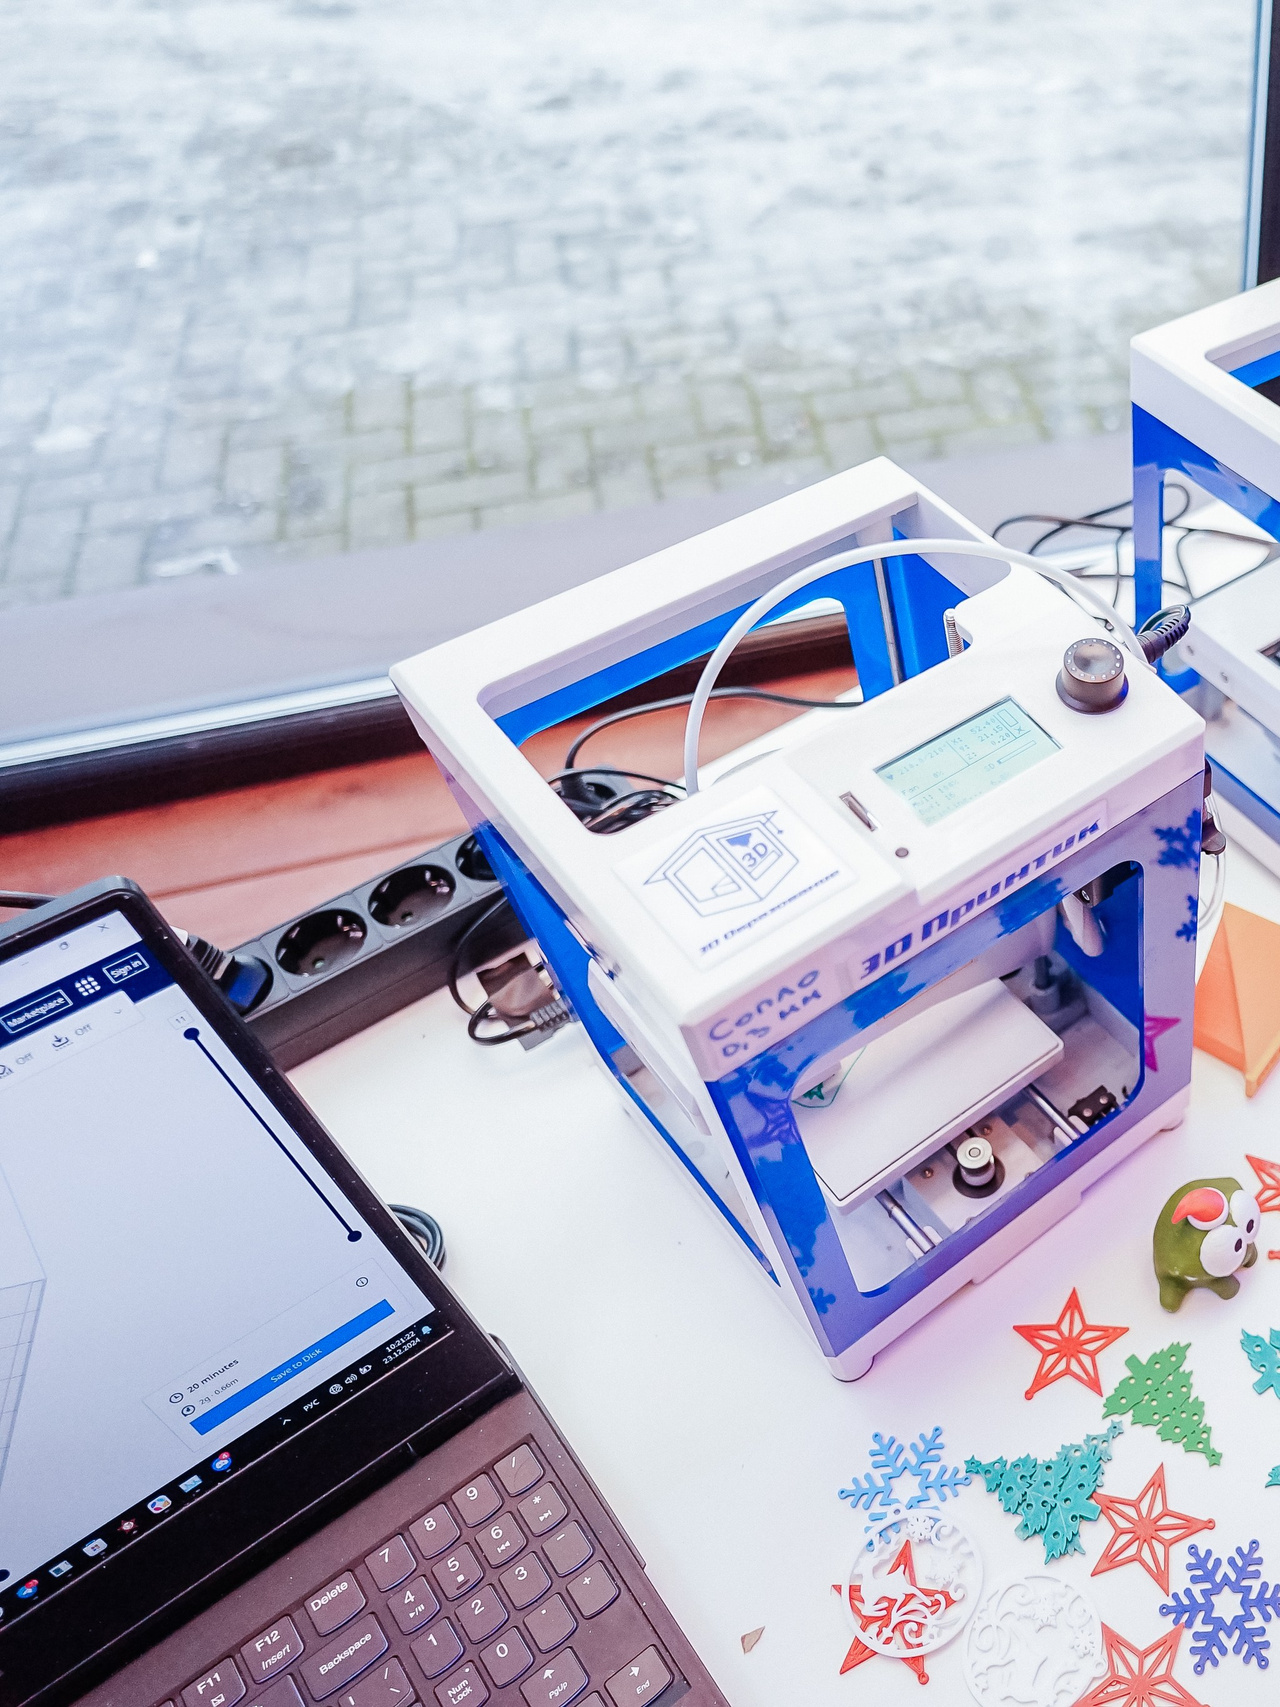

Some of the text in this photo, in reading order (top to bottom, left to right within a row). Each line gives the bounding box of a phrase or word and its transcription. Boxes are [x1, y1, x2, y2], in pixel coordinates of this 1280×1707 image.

[741, 842, 769, 868] 3D
[860, 819, 1101, 980] 3D Принтик
[110, 964, 133, 977] Sign
[6, 996, 66, 1027] Marketplace
[75, 1024, 93, 1036] Off
[16, 1053, 34, 1065] Off
[385, 1330, 416, 1353] 10:21:22
[382, 1337, 421, 1365] 23.12.2024
[270, 1347, 323, 1383] Save to Disk
[187, 1359, 240, 1394] 20 minutes
[199, 1396, 212, 1405] 2g
[466, 1487, 478, 1500] 9
[424, 1517, 437, 1531] 8
[491, 1526, 503, 1540] 6
[379, 1548, 390, 1563] 7
[447, 1558, 459, 1571] 5
[515, 1567, 528, 1581] 3
[311, 1581, 349, 1612] Delete
[404, 1591, 415, 1605] 4
[471, 1600, 484, 1615] 2
[255, 1630, 281, 1652] F12
[427, 1634, 438, 1647] 1
[261, 1643, 292, 1670] Insert
[319, 1633, 372, 1675] Backspace
[496, 1643, 508, 1658] 0
[197, 1672, 221, 1694] F11
[447, 1679, 469, 1697] Num
[548, 1681, 568, 1699] PgUp
[636, 1680, 650, 1695] End
[451, 1685, 473, 1705] Lock
